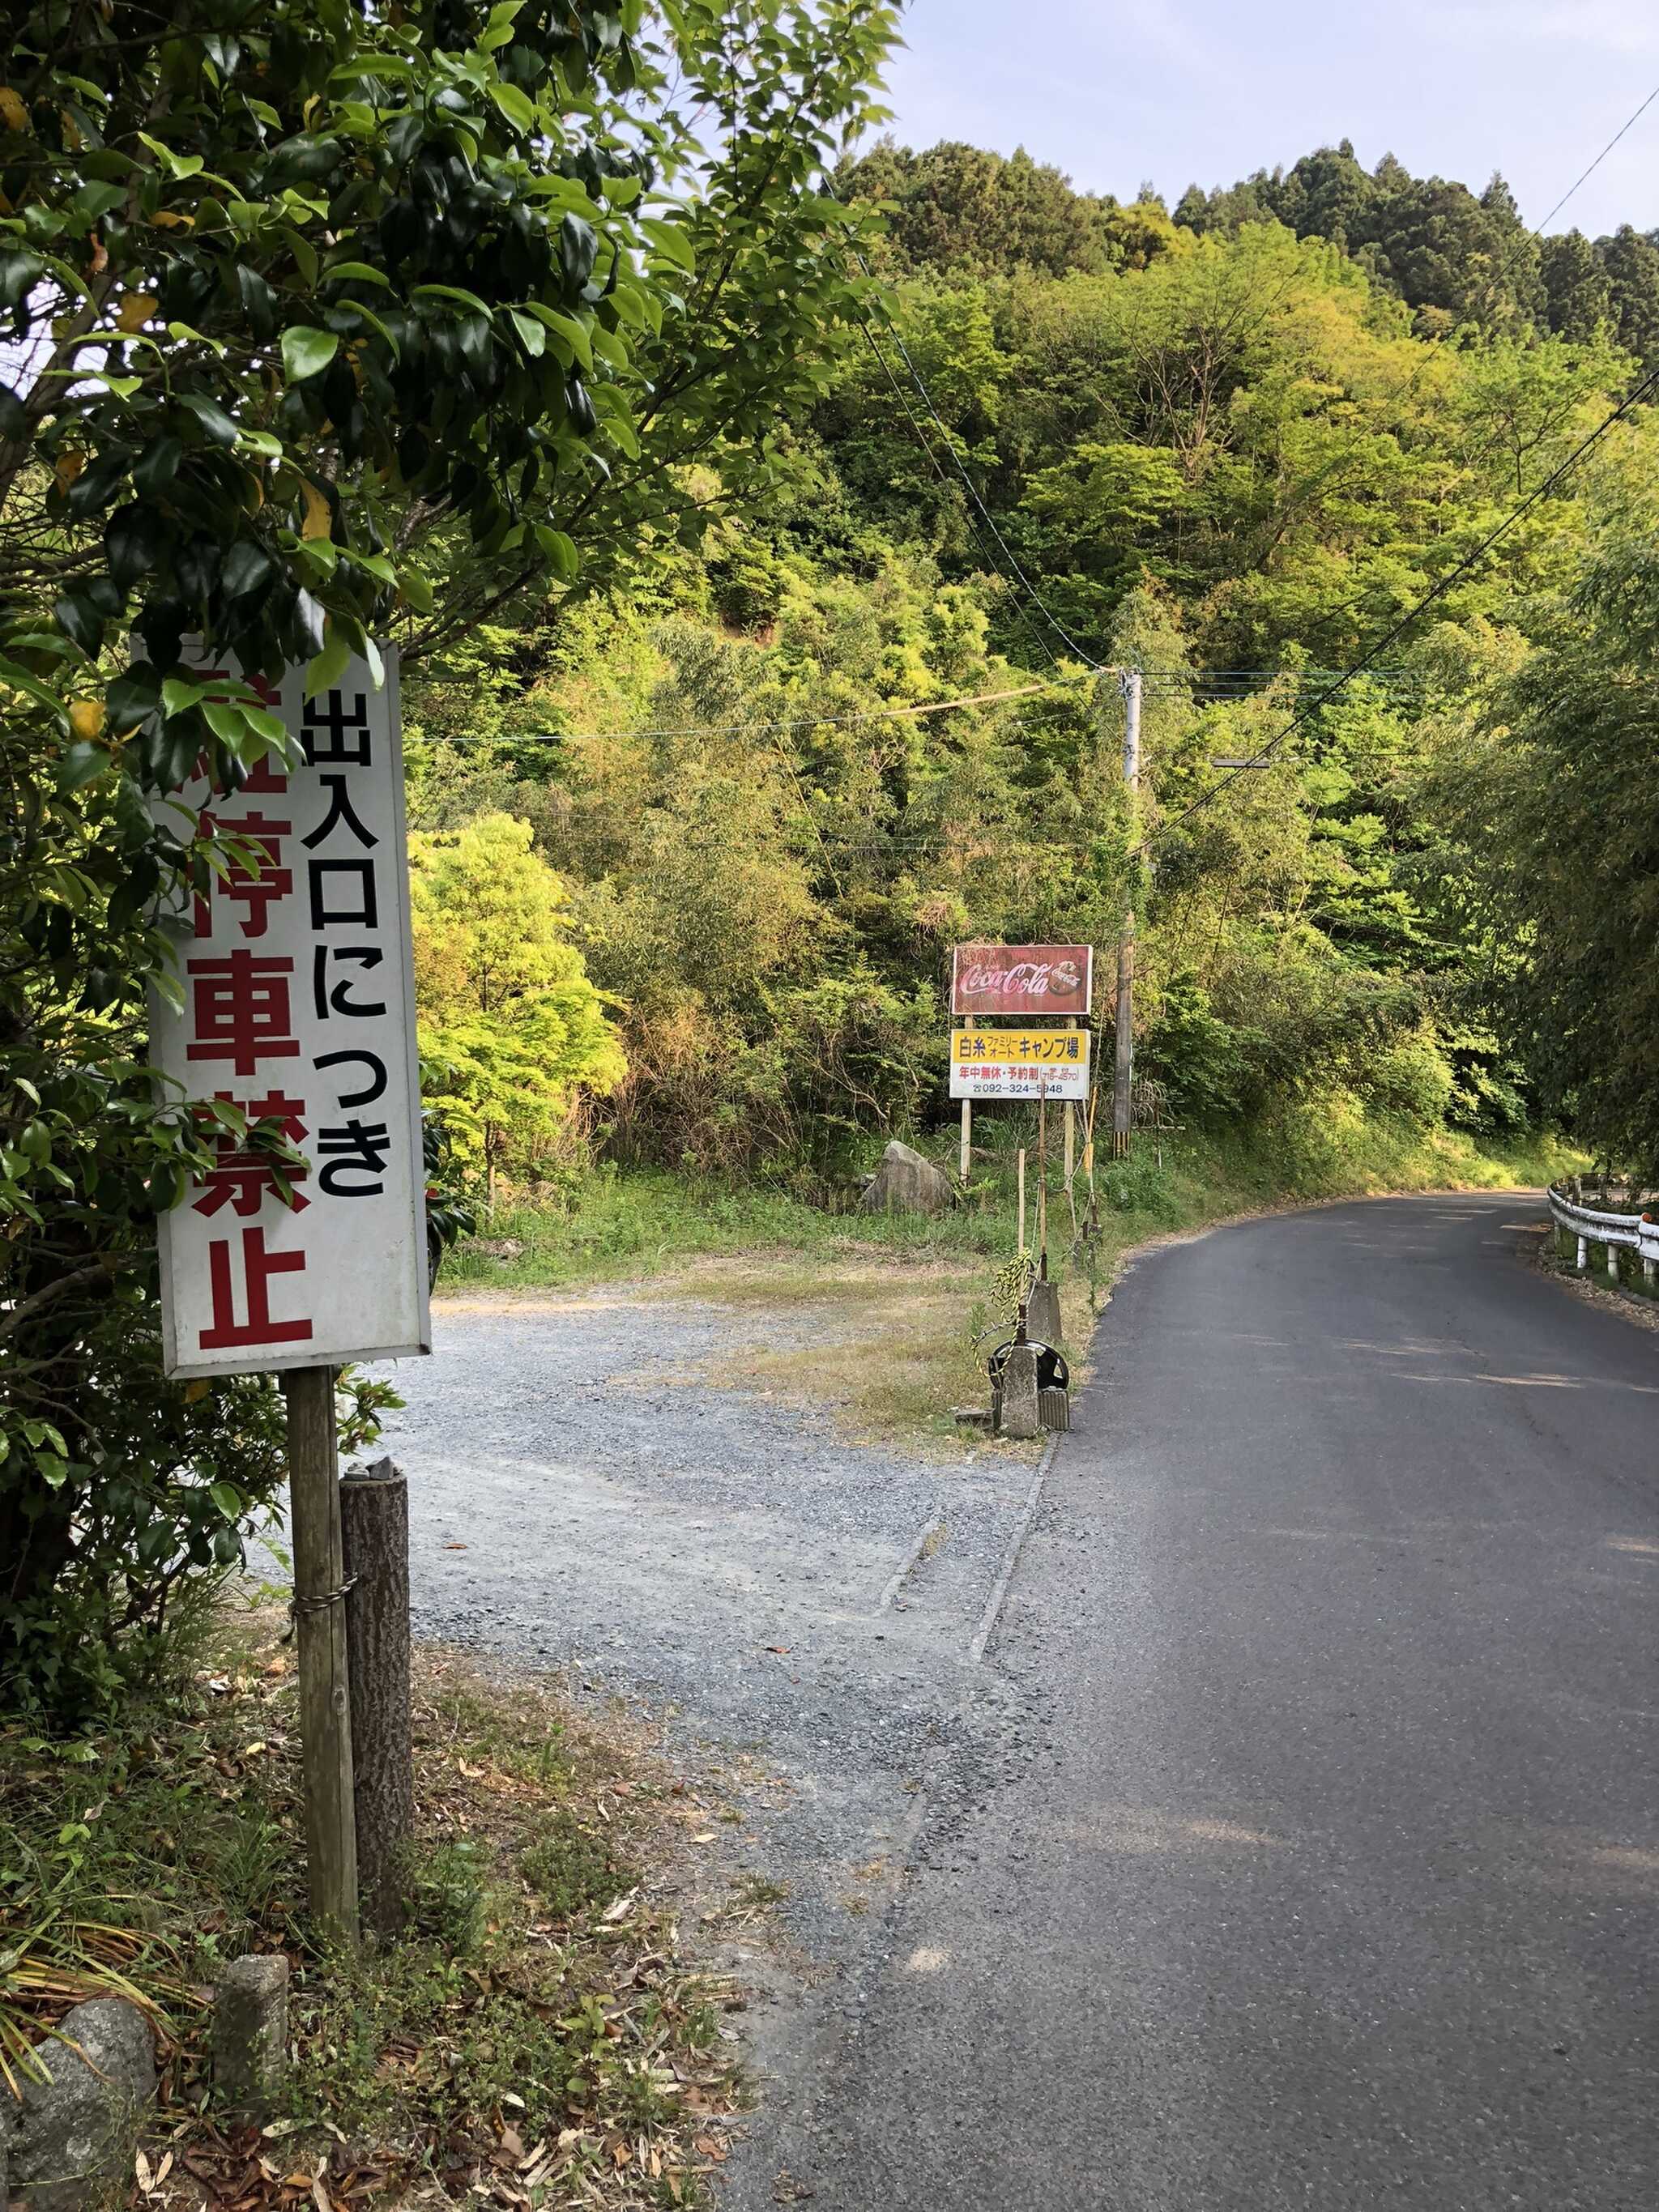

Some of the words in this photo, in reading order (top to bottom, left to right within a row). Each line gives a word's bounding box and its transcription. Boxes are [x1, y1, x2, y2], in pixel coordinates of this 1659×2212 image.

[301, 689, 391, 1197] 出入口につき
[959, 962, 1053, 995] Coca-Cola
[959, 1036, 986, 1058] 白糸
[987, 1036, 1018, 1047] ファミリー
[1019, 1036, 1079, 1059] キャンプ場
[990, 1047, 1014, 1058] オート
